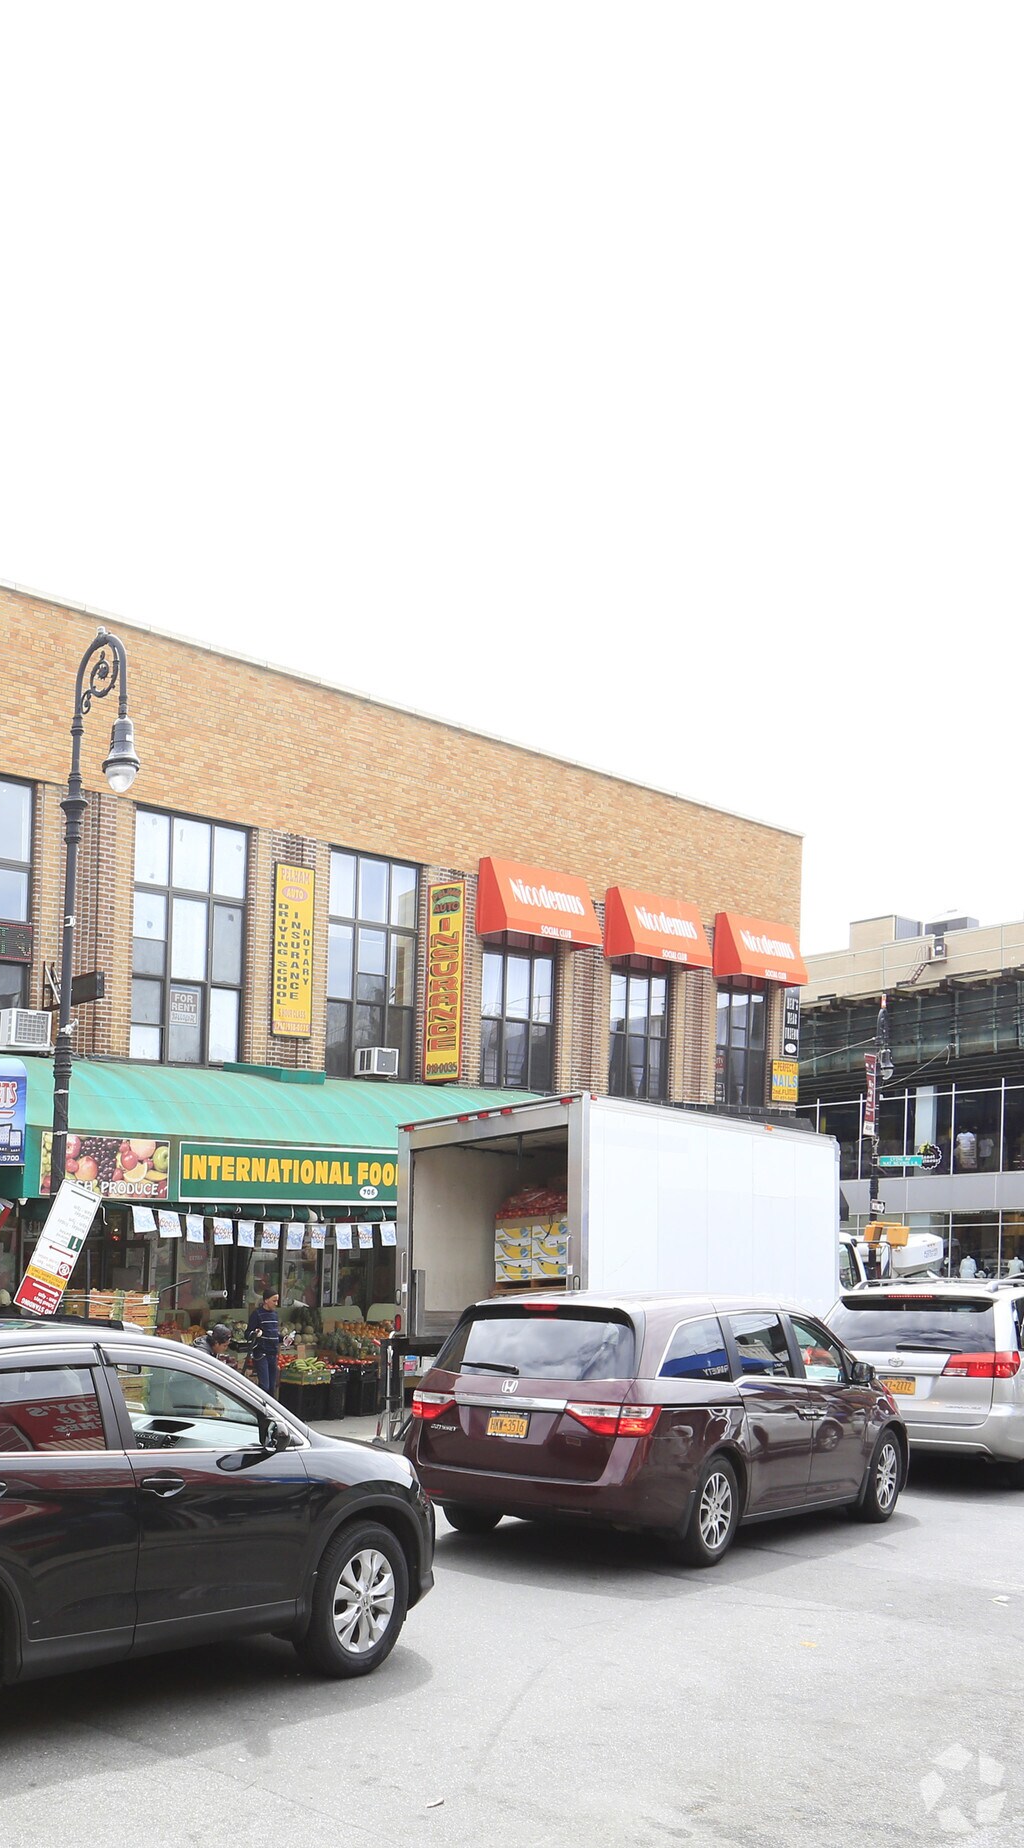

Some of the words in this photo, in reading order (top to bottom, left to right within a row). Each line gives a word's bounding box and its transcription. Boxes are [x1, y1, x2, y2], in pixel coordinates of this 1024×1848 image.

[281, 867, 311, 885] PELHAM
[286, 888, 304, 900] AUTO
[508, 877, 585, 916] Nicodemus
[433, 900, 460, 914] AUTO
[277, 903, 289, 956] DRIVING
[541, 925, 559, 937] SOCIAL
[559, 928, 572, 939] CLUB
[633, 904, 698, 940] Nicodemus
[289, 911, 301, 1000] INSURANCE
[739, 928, 795, 960] Nicodemus
[302, 928, 311, 986] NOTARY
[276, 960, 288, 1006] SCHOOL
[428, 917, 459, 1052] INSURANCE
[171, 1002, 196, 1012] RENT
[174, 993, 194, 1003] FOR
[772, 1074, 799, 1088] NAILS
[182, 1154, 353, 1185] INTERNATIONAL
[100, 1181, 159, 1195] PRODUCE
[20, 1297, 45, 1313] STANDING
